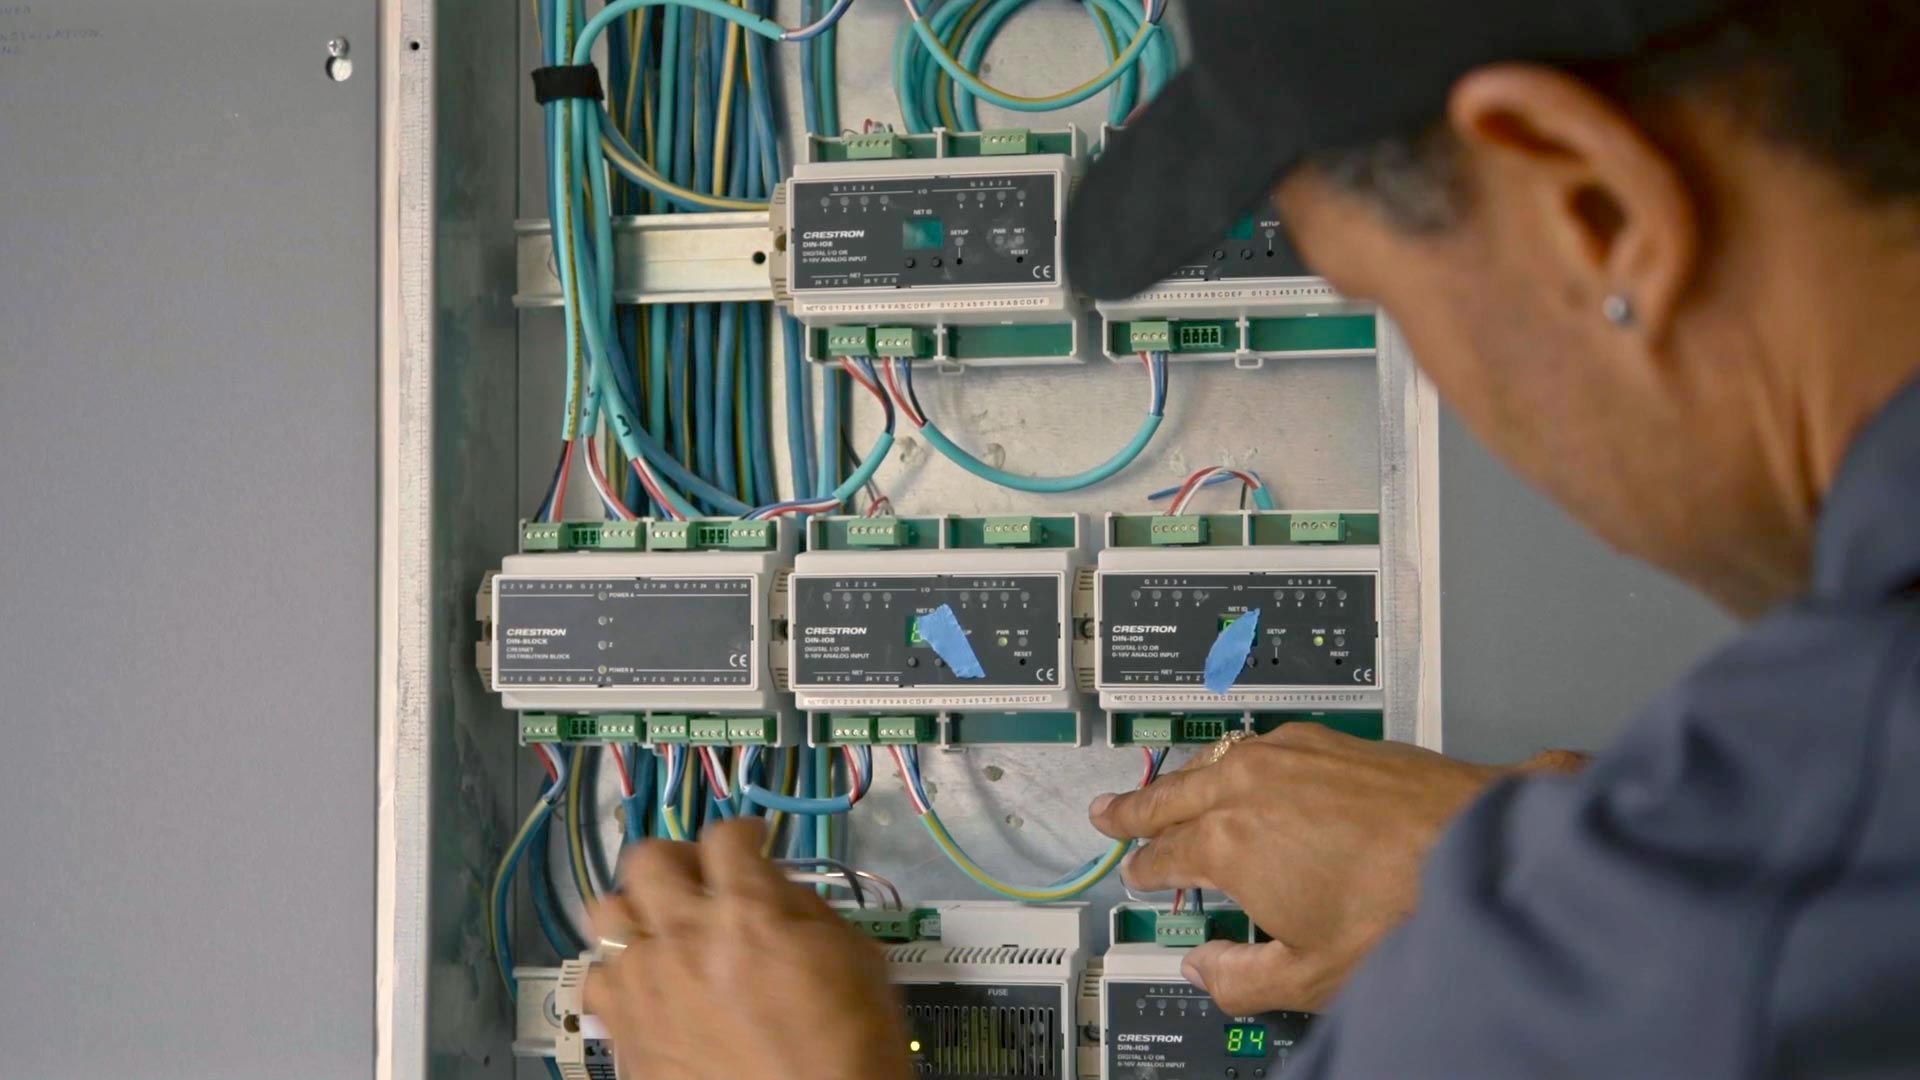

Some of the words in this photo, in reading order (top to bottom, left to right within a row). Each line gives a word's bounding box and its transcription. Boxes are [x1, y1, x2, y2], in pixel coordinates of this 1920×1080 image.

[802, 230, 865, 239] CRESTRON
[506, 628, 566, 636] CRESTRON
[805, 627, 867, 635] CRESTRON
[1112, 625, 1177, 633] CRESTRON
[987, 988, 1009, 996] FUSE
[1118, 1034, 1183, 1043] CRESTRON
[1228, 1029, 1265, 1052] 84
